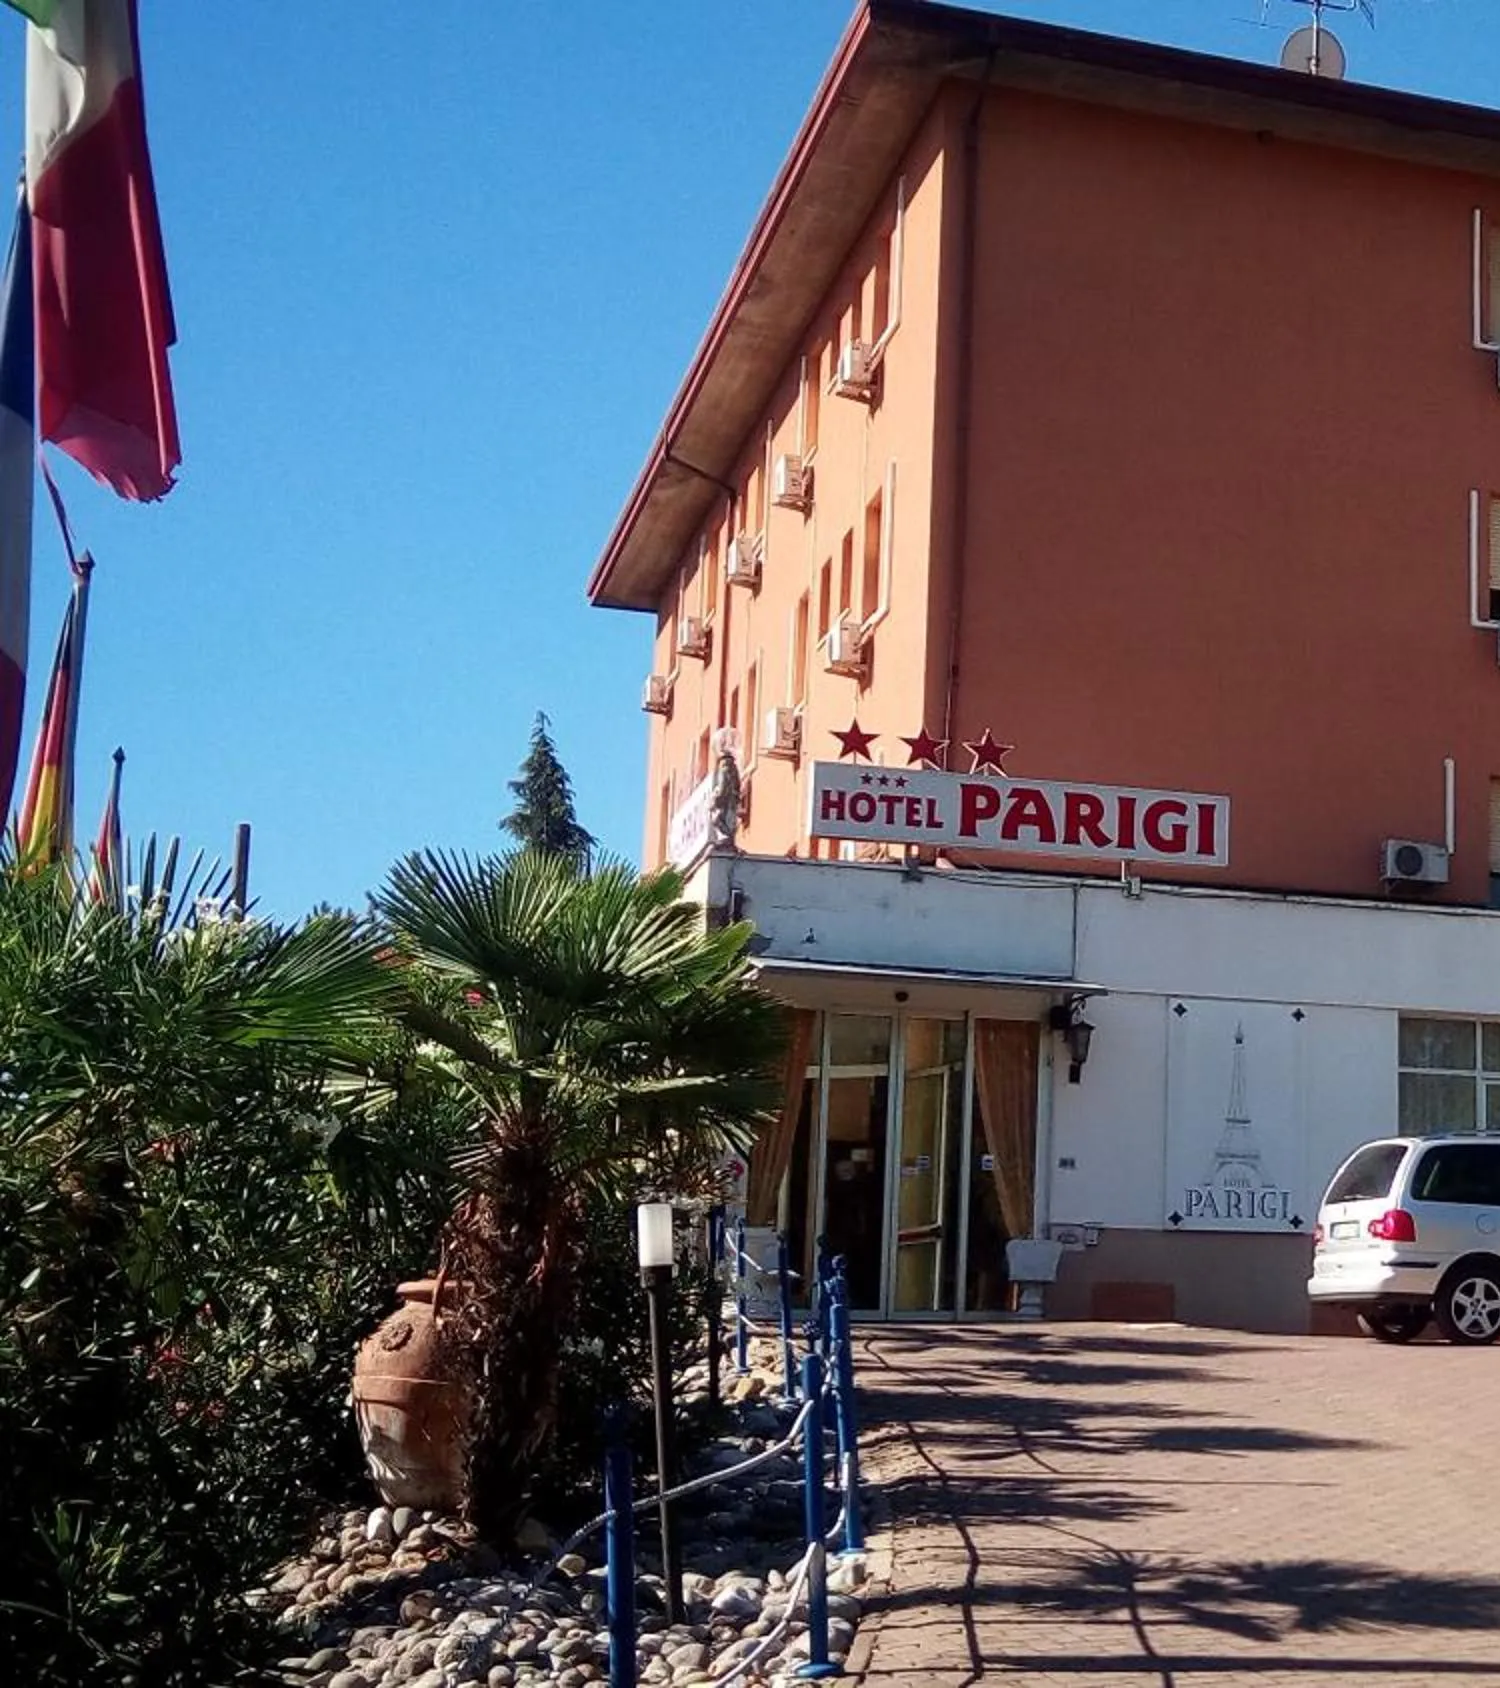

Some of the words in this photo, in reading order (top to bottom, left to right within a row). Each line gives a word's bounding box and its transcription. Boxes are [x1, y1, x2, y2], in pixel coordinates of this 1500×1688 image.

[820, 789, 944, 829] HOTEL
[958, 783, 1217, 857] PARIGI
[1184, 1188, 1291, 1219] PARIGI
